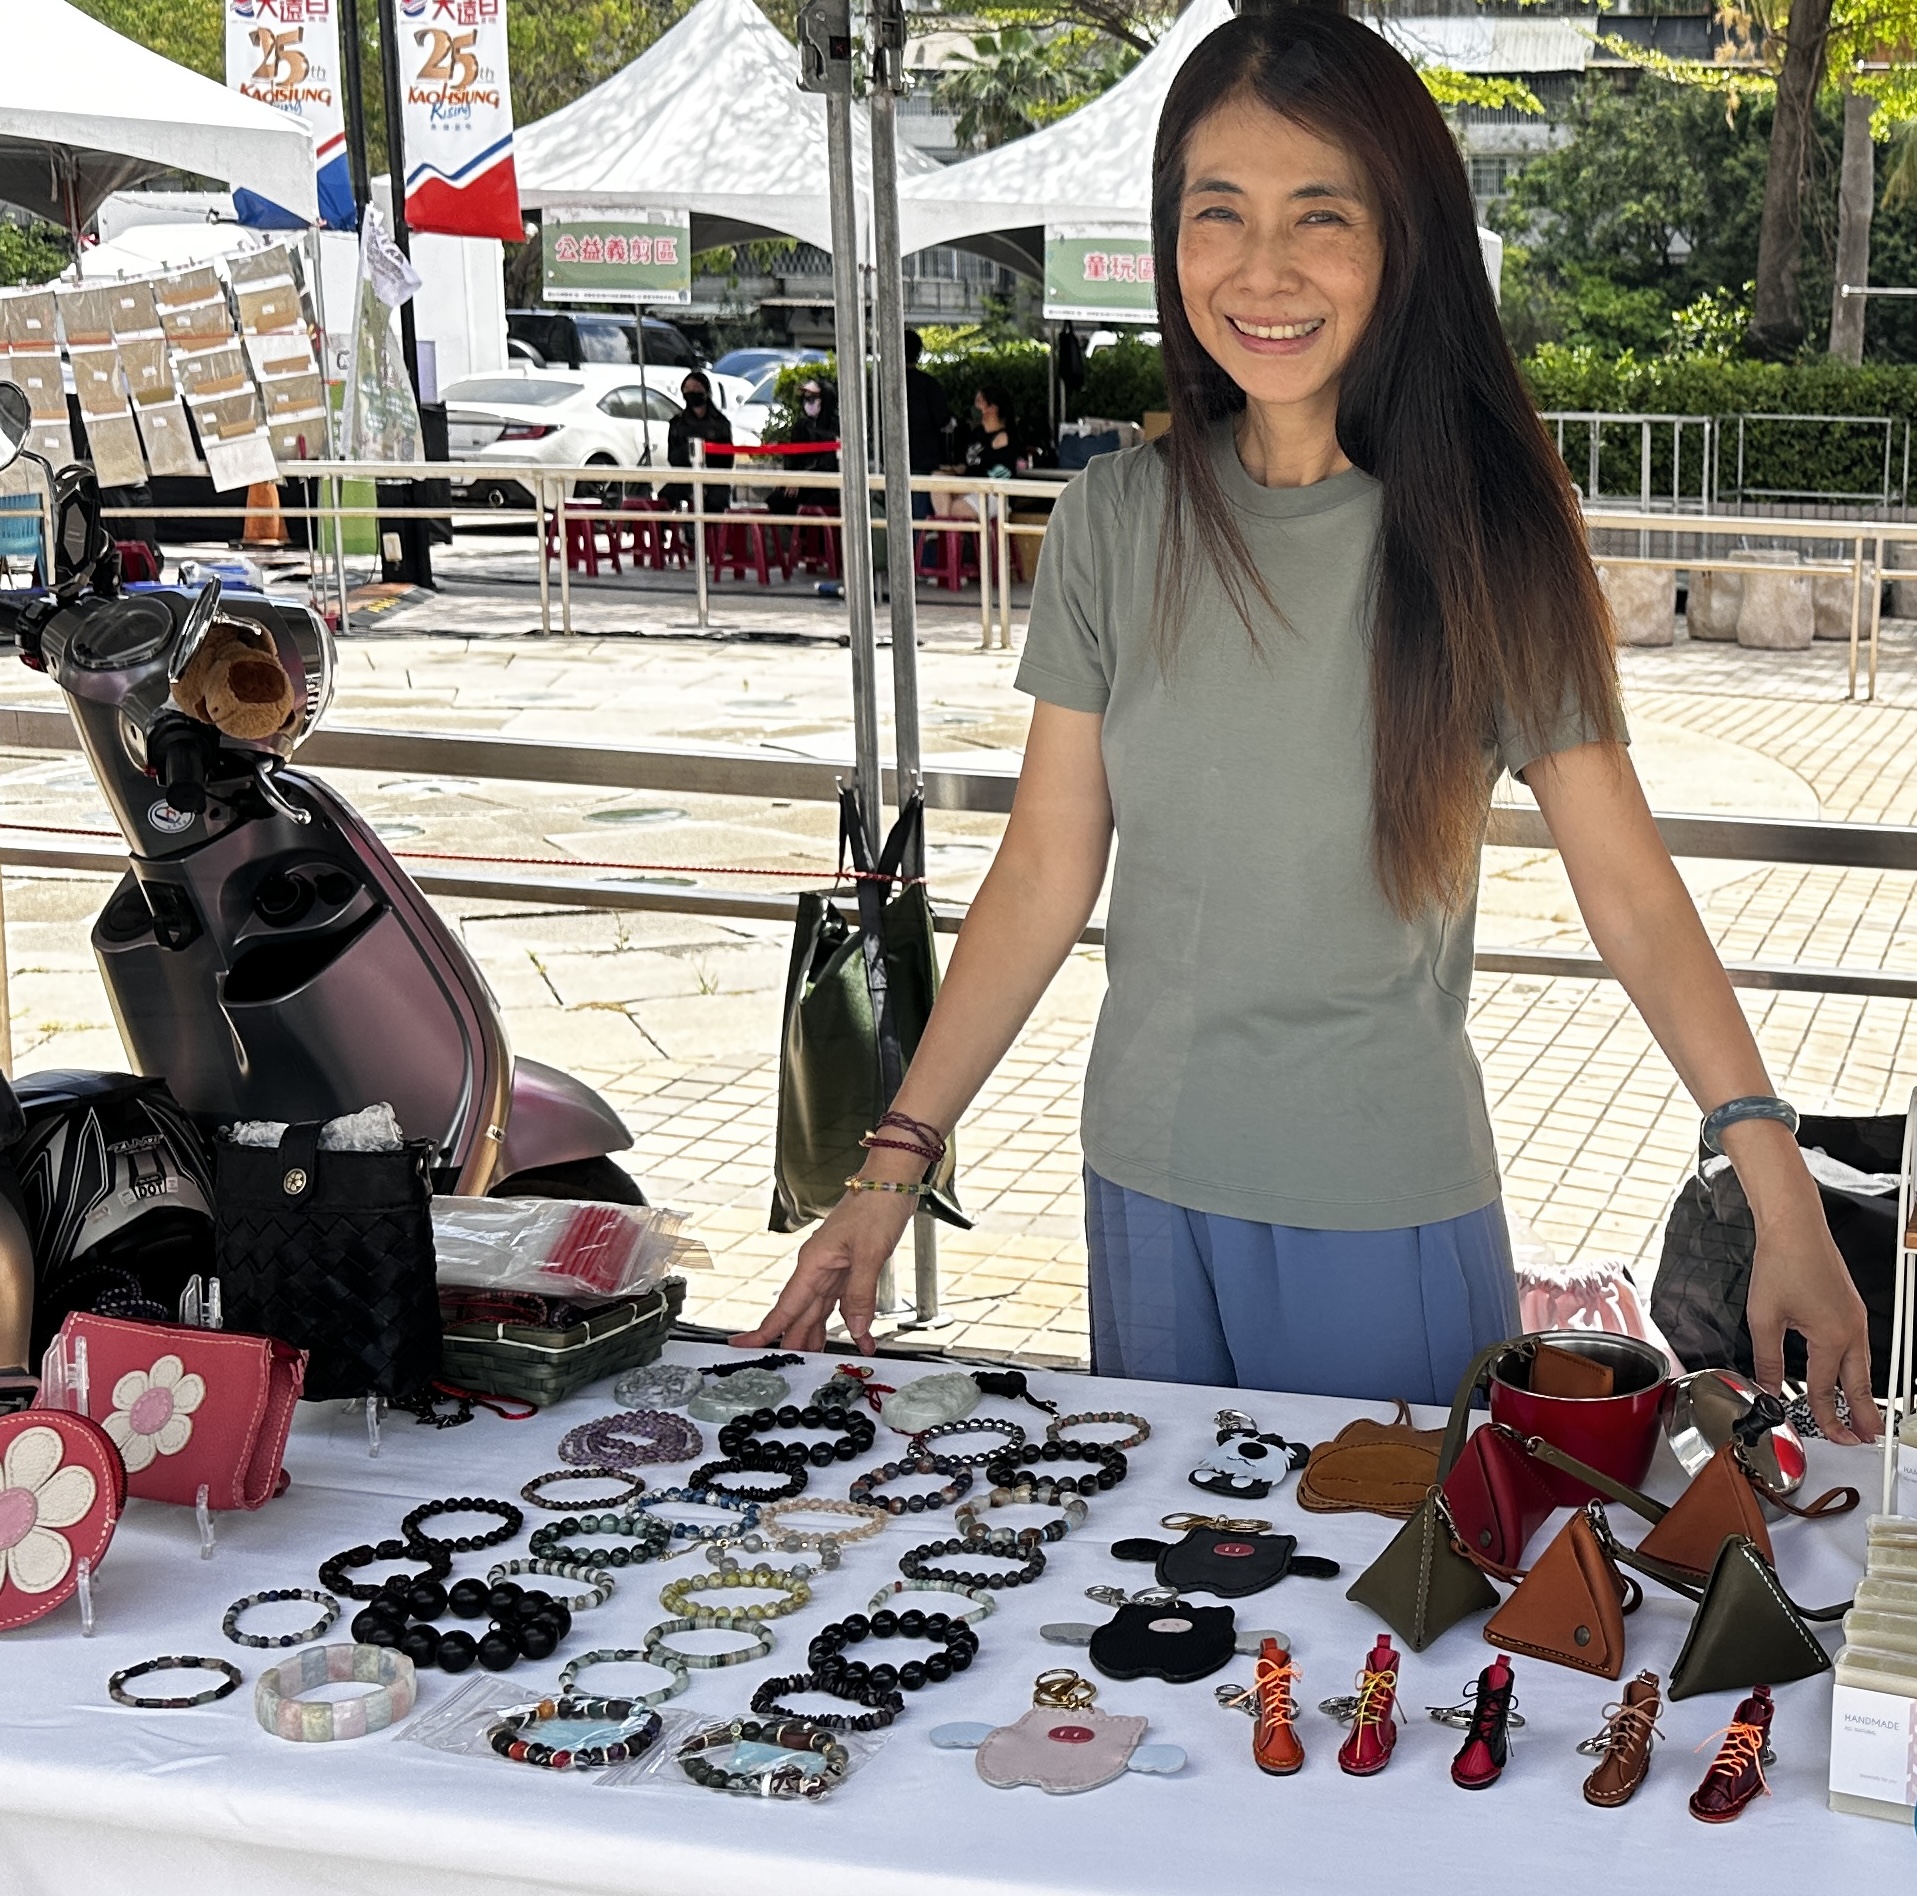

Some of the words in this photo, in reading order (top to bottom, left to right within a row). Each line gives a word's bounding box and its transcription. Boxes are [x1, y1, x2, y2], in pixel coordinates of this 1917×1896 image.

[408, 83, 501, 109] KAOHSIUNG
[430, 101, 472, 121] Rising
[555, 234, 678, 265] 公益義剪區
[138, 1181, 165, 1198] DOT
[1844, 1713, 1901, 1731] HANDMADE
